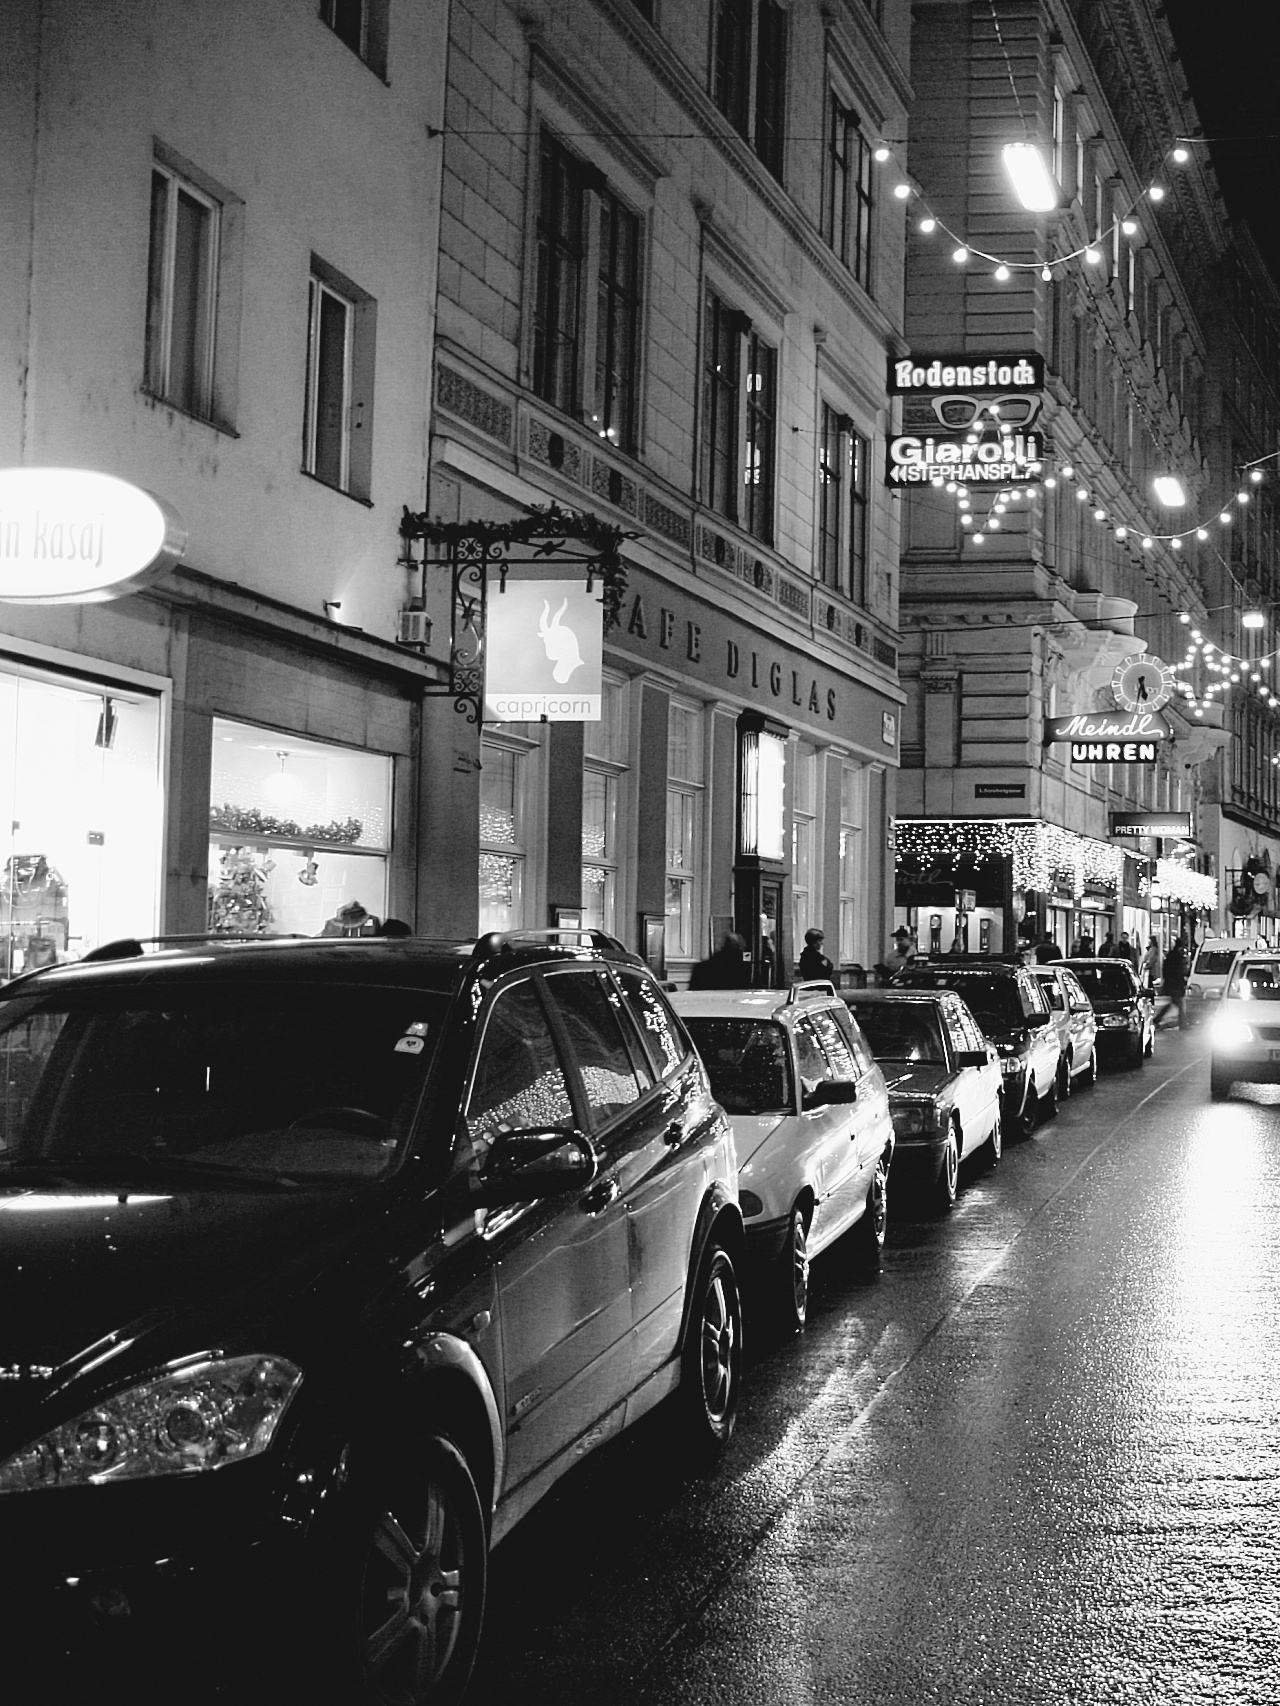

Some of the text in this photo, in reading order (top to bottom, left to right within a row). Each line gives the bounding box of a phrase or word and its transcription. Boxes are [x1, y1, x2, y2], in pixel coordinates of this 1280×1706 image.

[895, 360, 1035, 387] Rodenstock
[34, 510, 104, 568] kasaj
[628, 594, 837, 721] AFE DIGLAS
[496, 696, 591, 718] capricorn
[1056, 714, 1164, 737] Meindl
[1072, 743, 1155, 760] UHREN
[1115, 826, 1190, 836] PRETTY WOMAN
